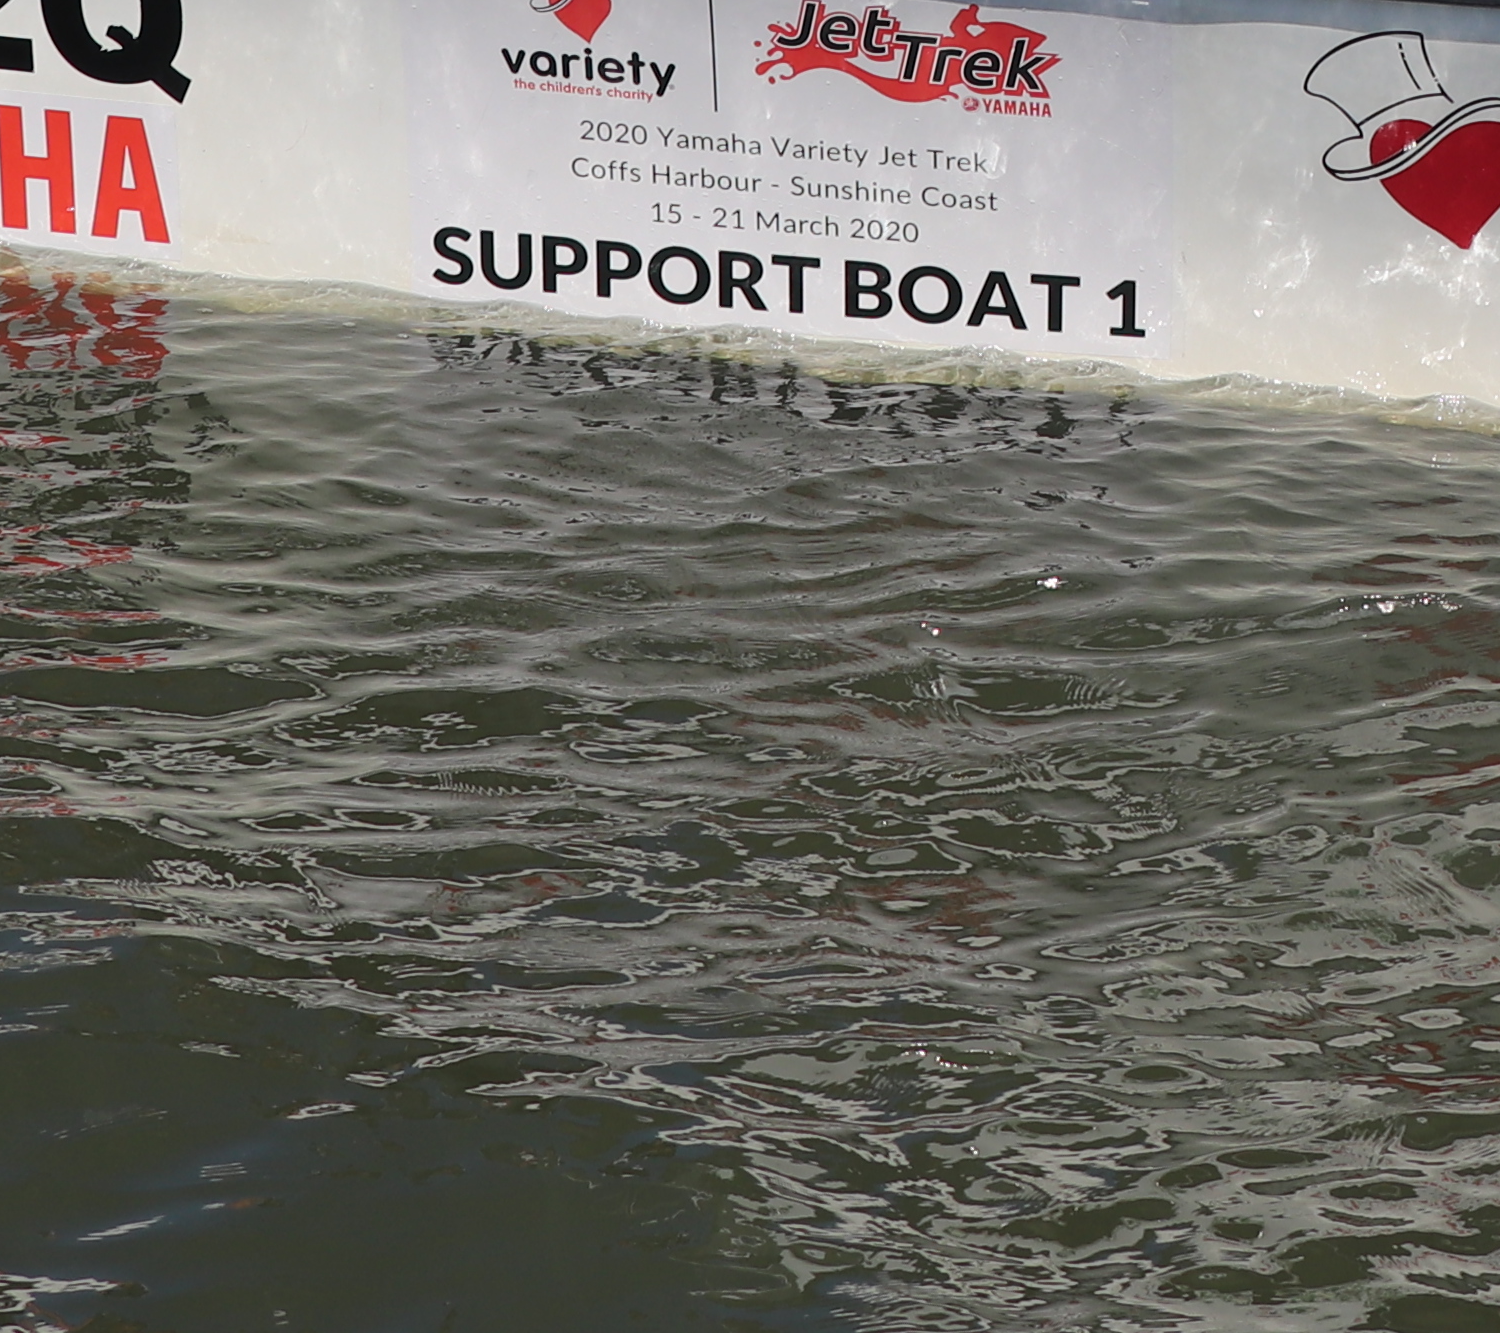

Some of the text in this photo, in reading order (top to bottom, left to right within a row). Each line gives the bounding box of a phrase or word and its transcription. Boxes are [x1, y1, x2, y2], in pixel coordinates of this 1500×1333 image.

[501, 47, 676, 97] variety
[513, 78, 654, 103] the children's charity
[982, 98, 1052, 118] YAMAHA
[579, 119, 988, 174] 2020 Yamaha Variety Jet Trek
[571, 156, 642, 183] Coffs
[651, 163, 763, 194] Harbour
[791, 175, 912, 205] Sunshine
[921, 187, 999, 212] Coast
[651, 201, 683, 225] 15
[712, 206, 746, 230] 21
[756, 210, 841, 238] March
[850, 218, 920, 244] 2020
[432, 226, 1147, 338] SUPPORT BOAT 1
